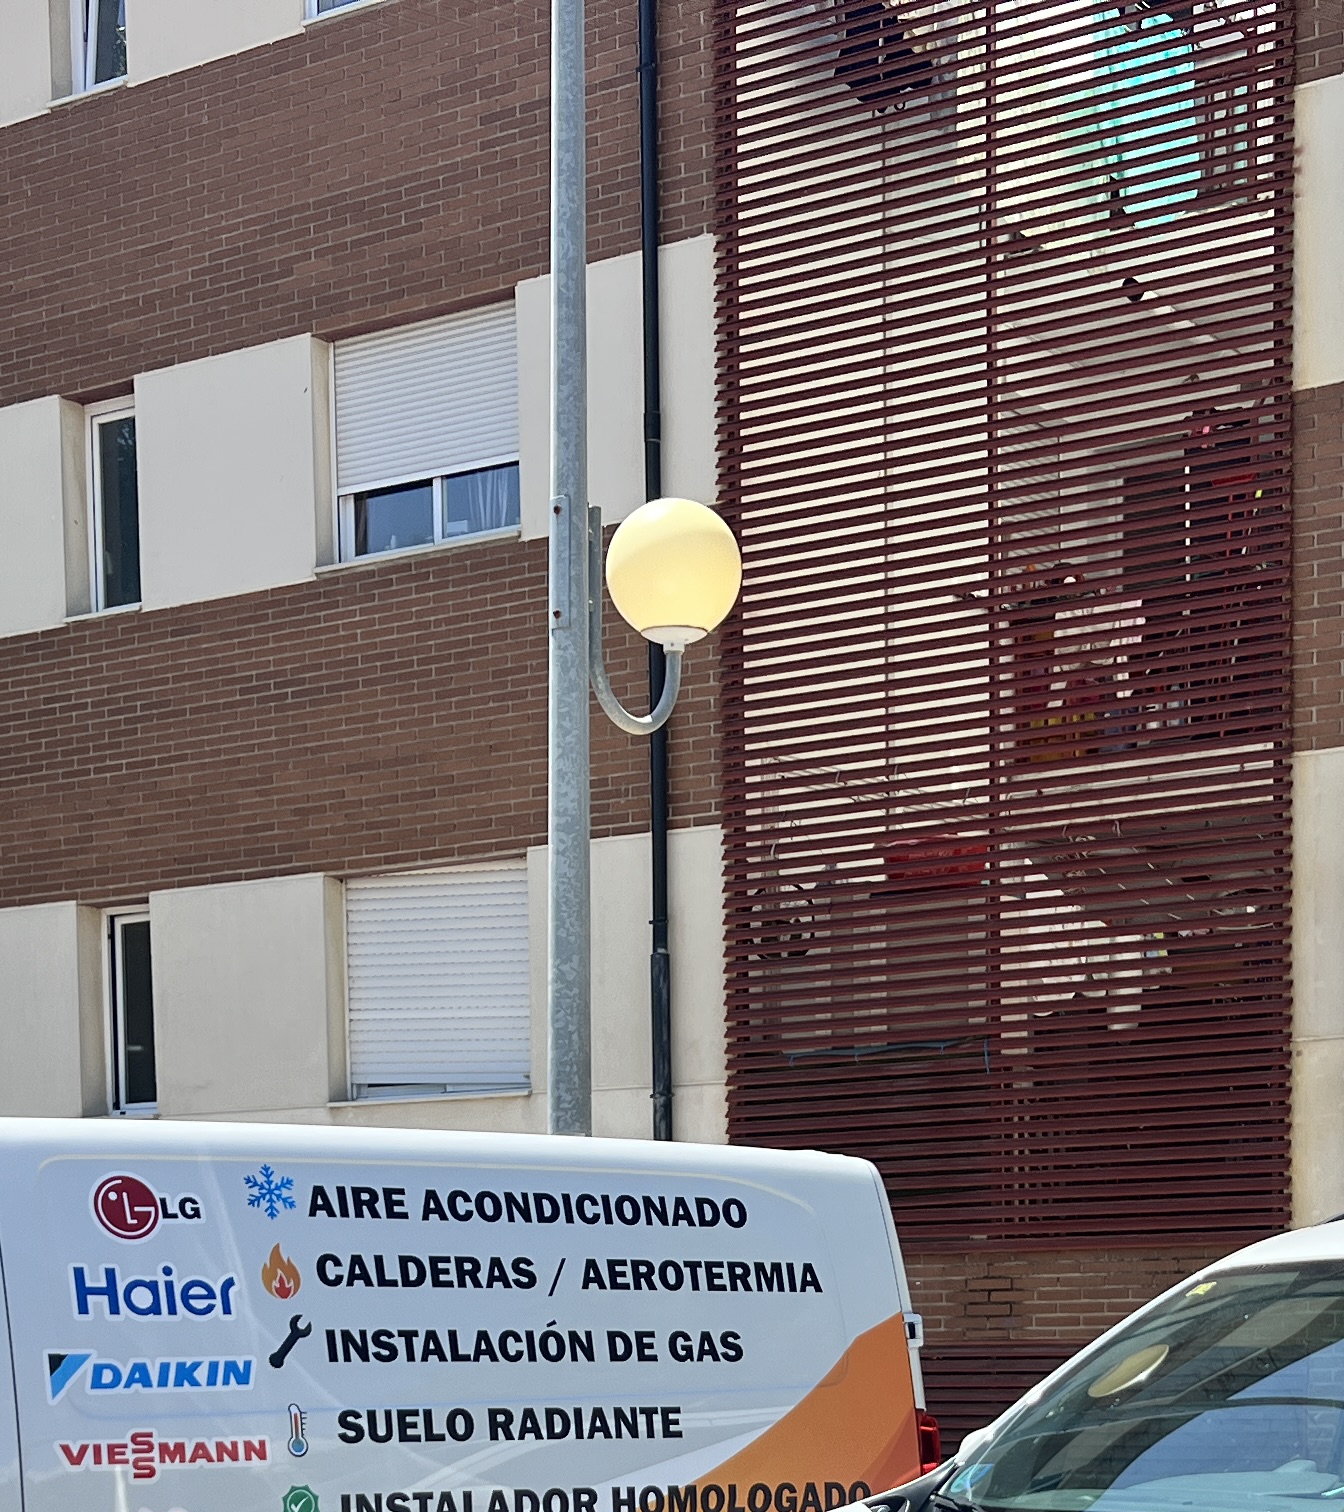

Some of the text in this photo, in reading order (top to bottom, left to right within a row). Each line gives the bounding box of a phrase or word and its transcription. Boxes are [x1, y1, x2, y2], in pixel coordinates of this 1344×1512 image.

[161, 1196, 202, 1220] LG
[308, 1185, 748, 1229] AIRE ACONDICIONADO
[73, 1265, 235, 1316] Haier
[316, 1253, 823, 1296] CALDERAS / AEROTERMIA
[325, 1321, 744, 1363] INSTALACIÓN DE GAS
[90, 1360, 253, 1390] DAIKIN
[338, 1406, 684, 1444] SUELO RADIANTE
[59, 1431, 268, 1479] VIESSMANN
